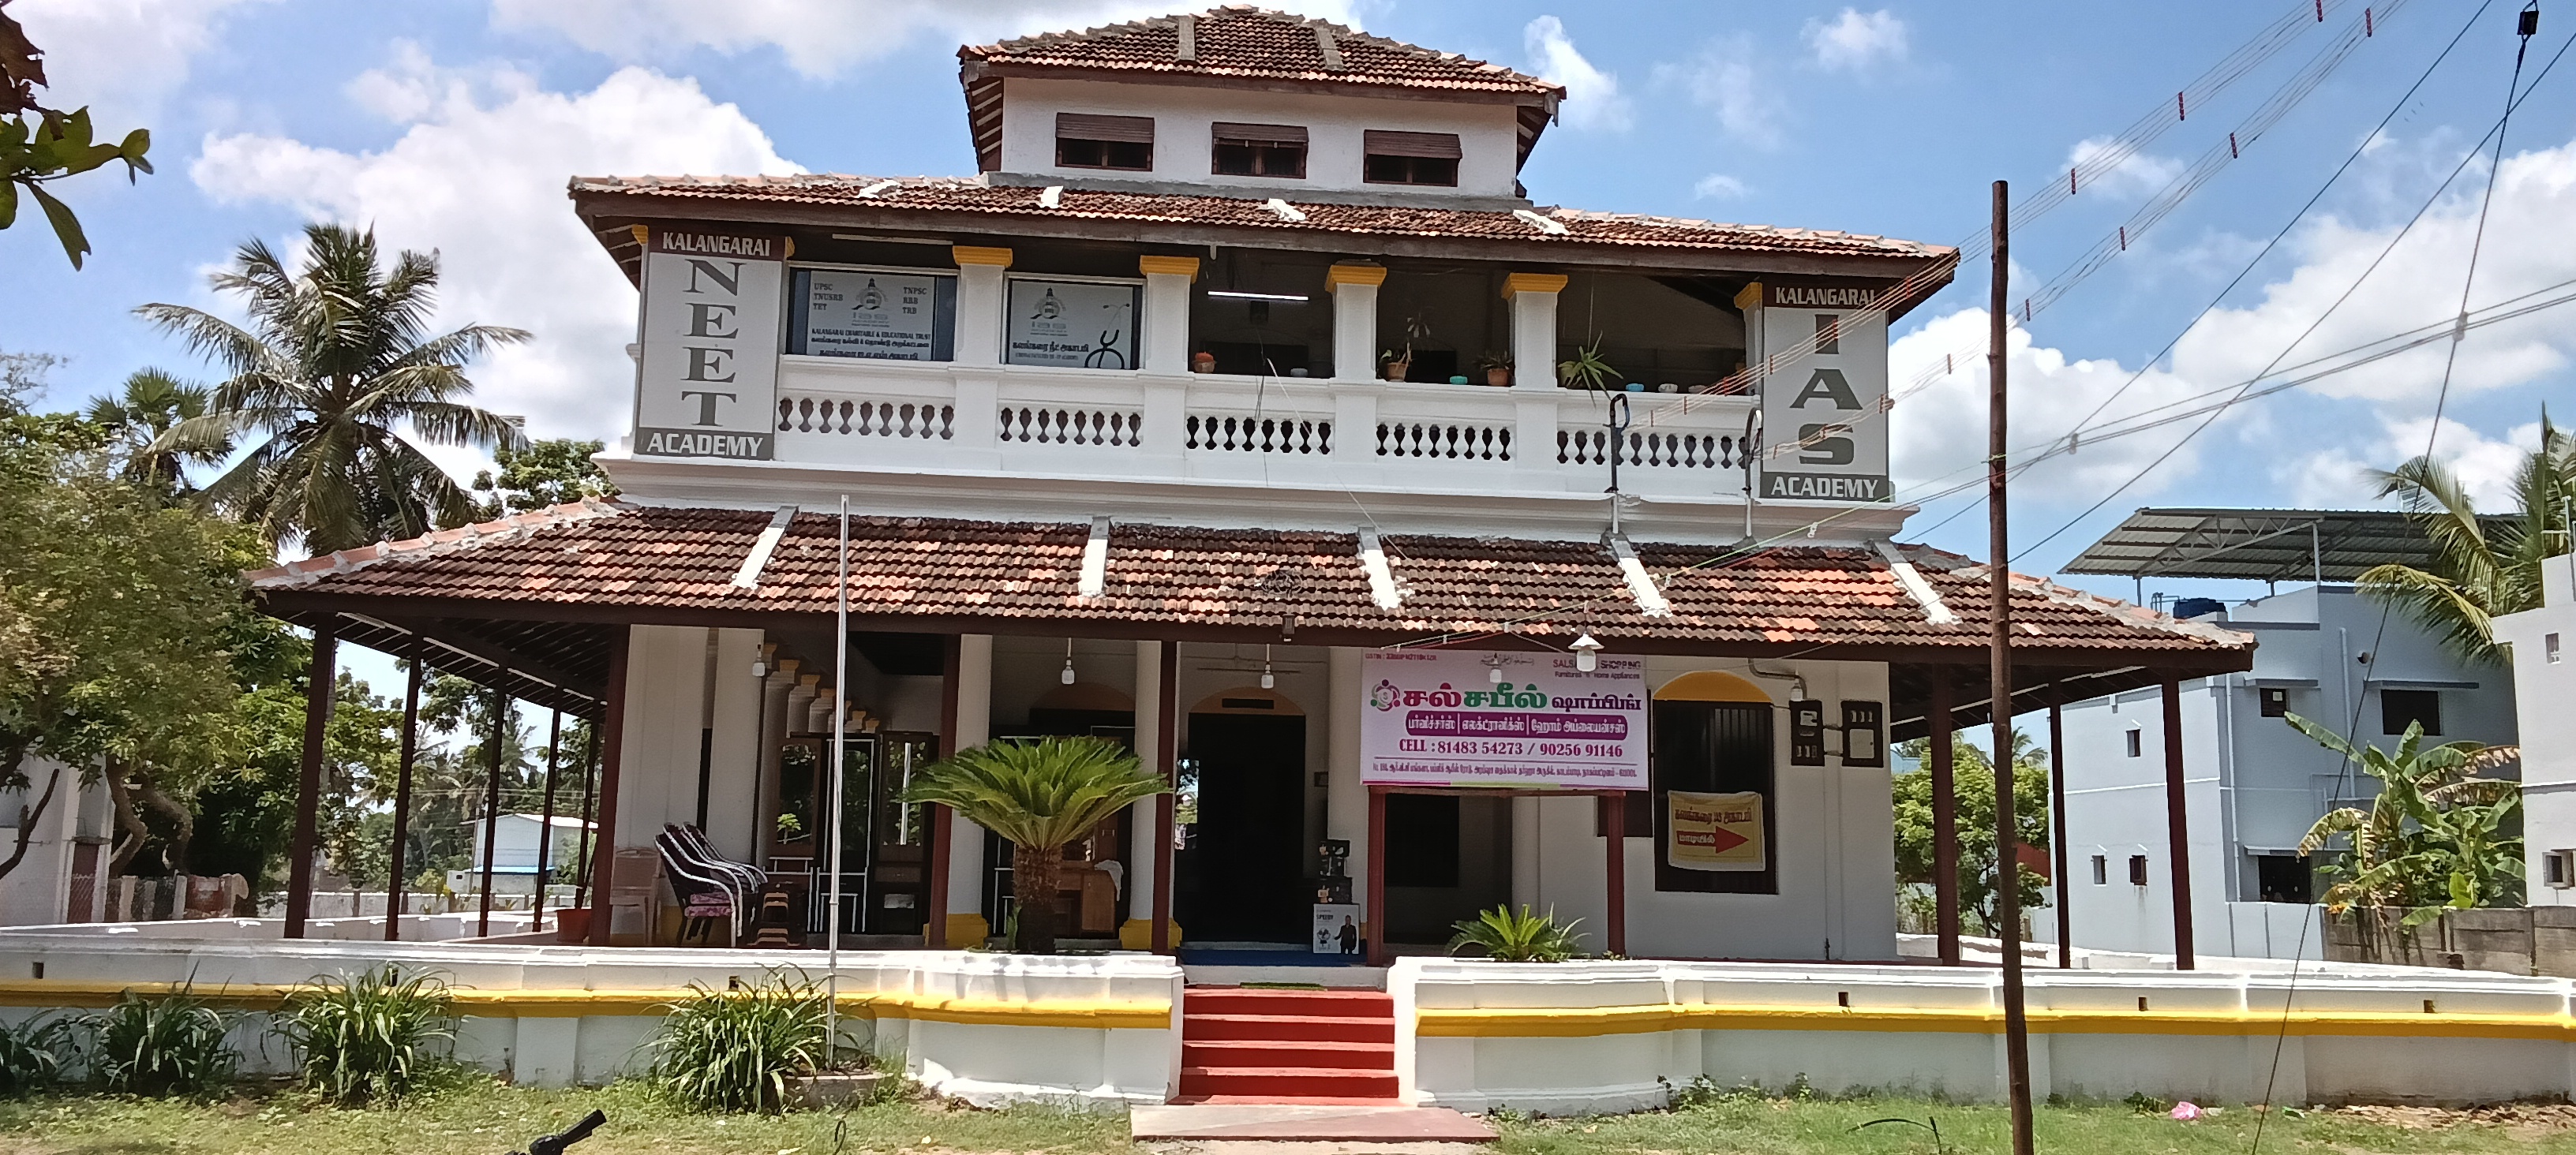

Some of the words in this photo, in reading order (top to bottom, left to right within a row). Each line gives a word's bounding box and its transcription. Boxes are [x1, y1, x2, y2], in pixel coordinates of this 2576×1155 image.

[663, 232, 770, 256] KALANGARAI
[814, 282, 833, 291] UPSC
[904, 286, 927, 295] TNPSC
[814, 293, 844, 301] TNUSRB
[1776, 287, 1874, 306] KALANGARAI
[902, 306, 918, 315] TRB
[646, 432, 763, 457] ACADEMY
[1770, 476, 1878, 499] ACADEMY
[1531, 717, 1563, 734] ஹோம்
[1399, 738, 1428, 753] CELL
[1481, 742, 1523, 755] 54273
[1526, 742, 1537, 756] /
[1540, 743, 1582, 757] 90256
[1585, 744, 1623, 757] 91146
